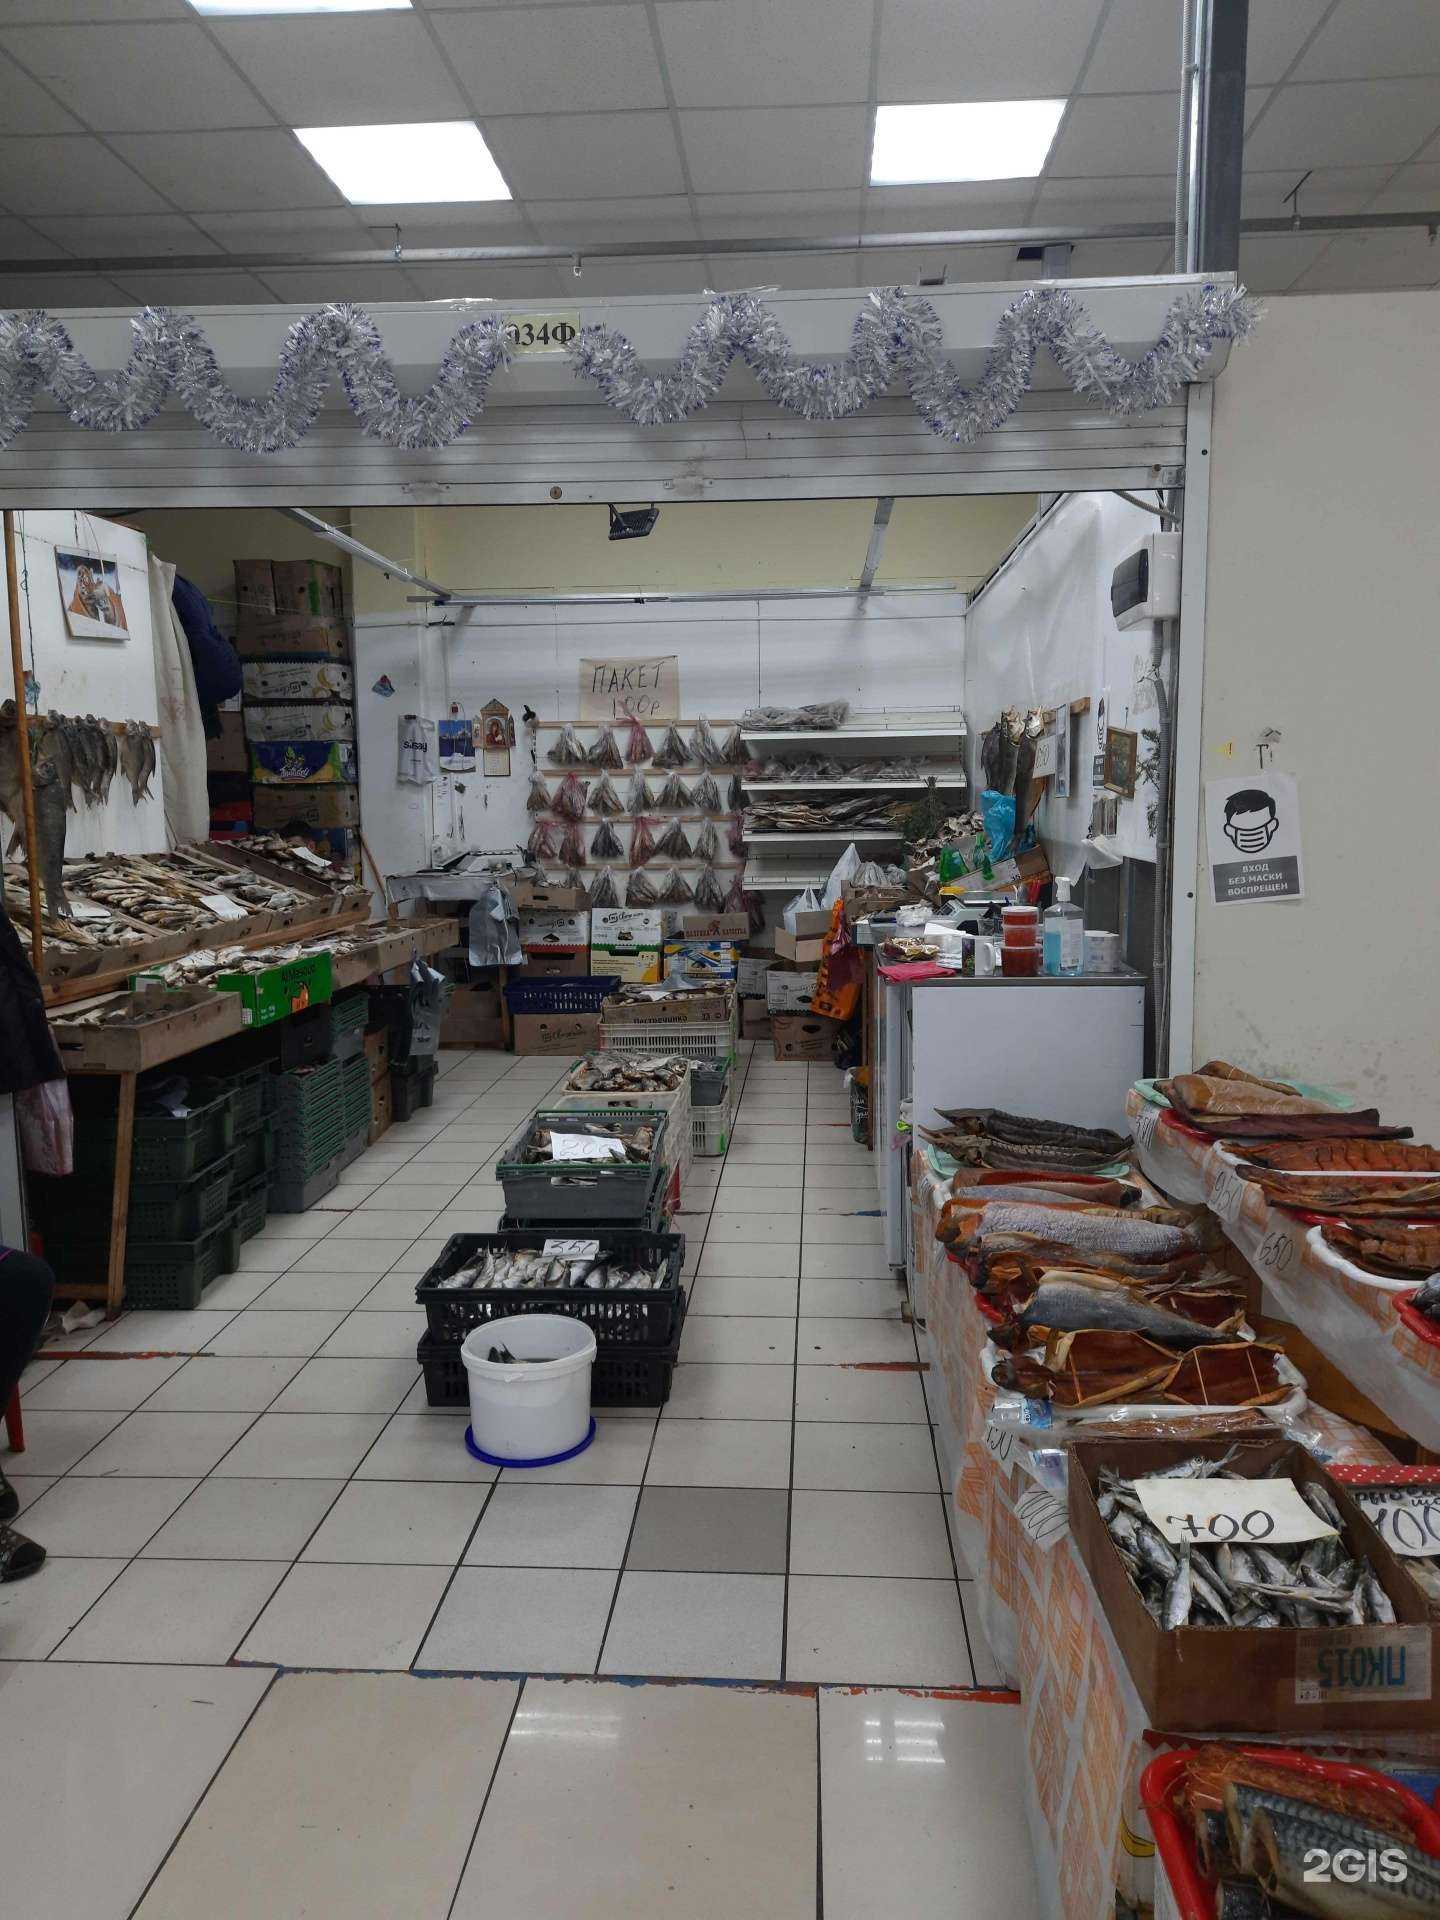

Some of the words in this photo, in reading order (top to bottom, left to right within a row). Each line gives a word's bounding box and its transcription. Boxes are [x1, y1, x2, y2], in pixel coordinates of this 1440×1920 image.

[592, 660, 665, 694] ПАКЕТ
[1228, 876, 1246, 886] БЕЗ
[1248, 872, 1283, 883] МАСКИ
[1242, 863, 1269, 873] ВХОД
[1227, 882, 1288, 896] ВОСПРЕЩЕН
[1166, 1509, 1275, 1541] 700
[1316, 1646, 1406, 1688] ПК015
